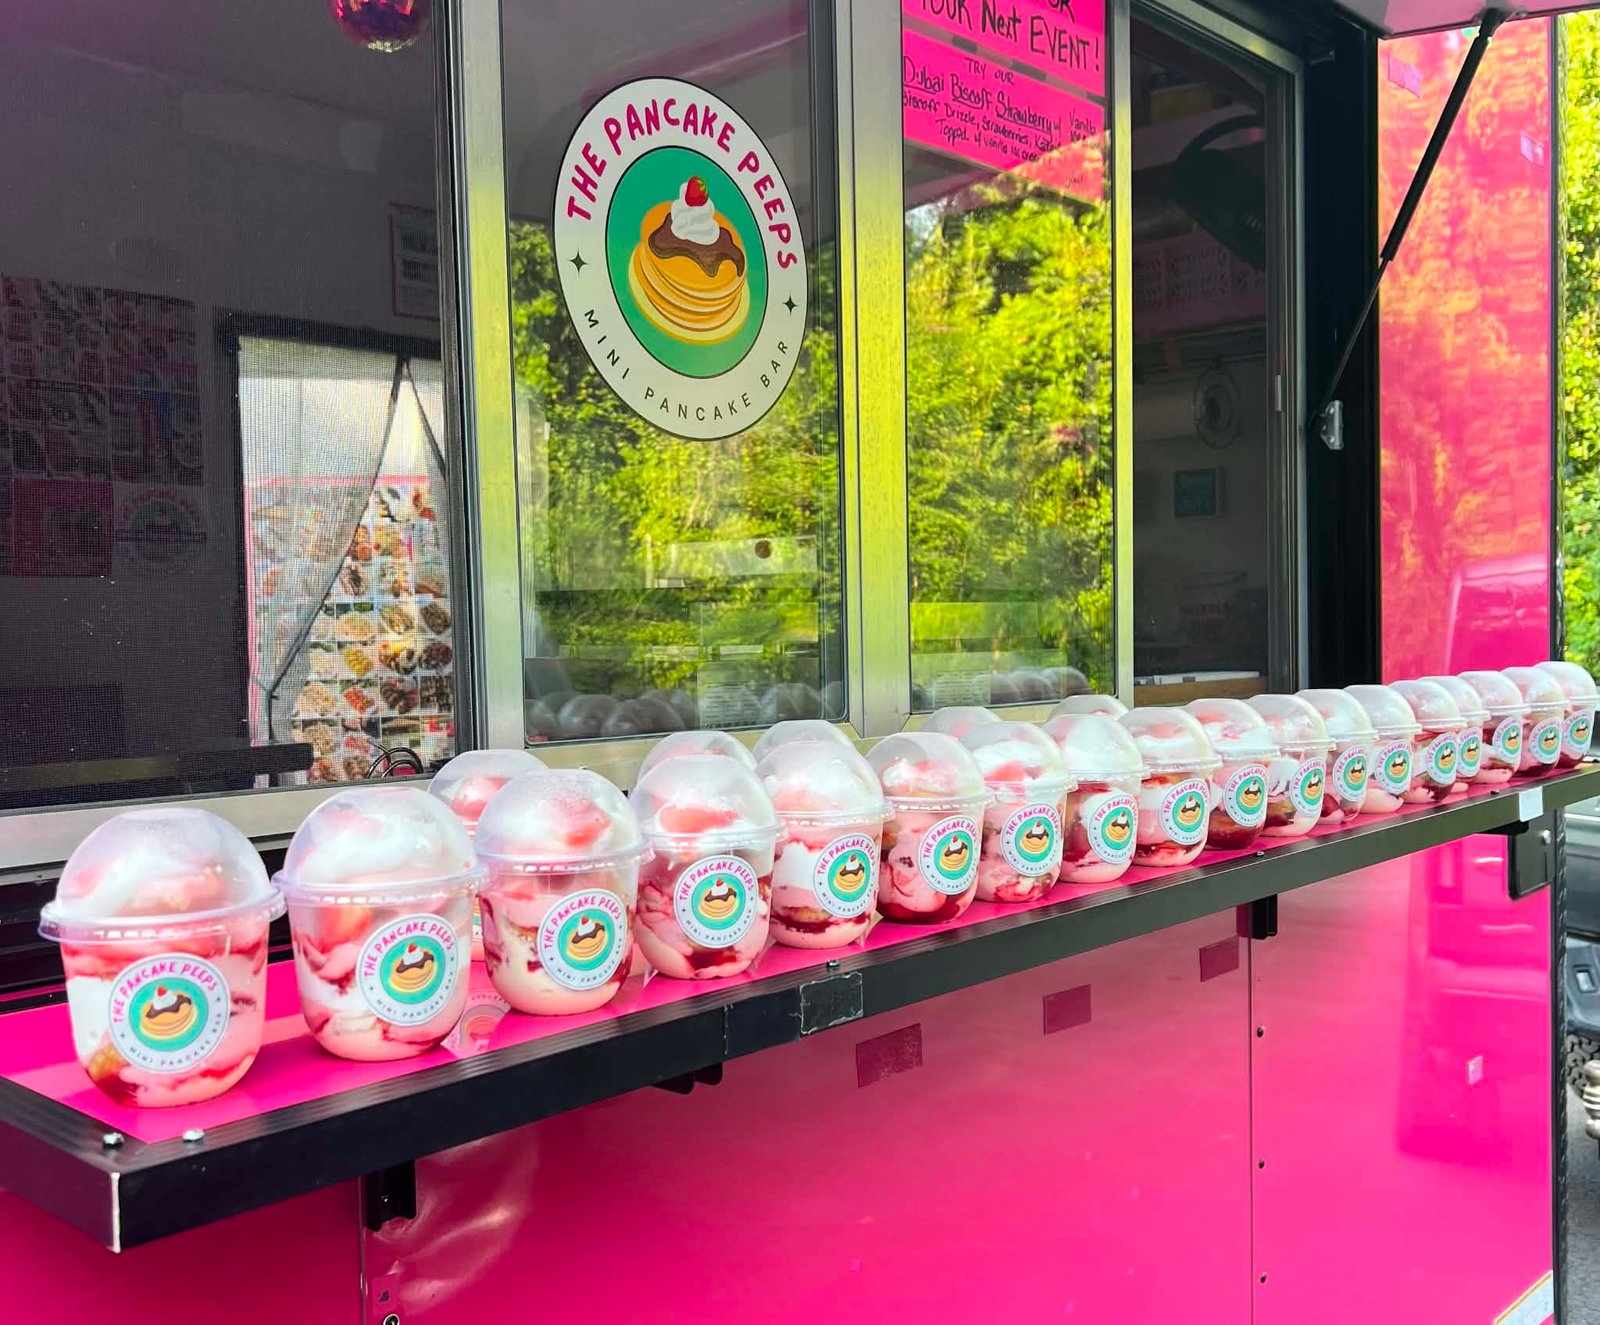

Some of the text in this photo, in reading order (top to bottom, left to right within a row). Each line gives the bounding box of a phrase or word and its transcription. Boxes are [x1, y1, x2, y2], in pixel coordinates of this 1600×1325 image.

[981, 0, 1021, 42] Next
[964, 57, 986, 79] TRY
[903, 55, 944, 93] Dubai
[950, 73, 993, 110] Biscoff
[996, 91, 1052, 146] Strawberry
[567, 98, 798, 269] THE PANCAKE PEEPS
[584, 309, 788, 420] MINI PANCAKE BAR
[923, 842, 933, 858] THE
[931, 820, 965, 841] PANCAKE
[1006, 820, 1018, 836] THE
[679, 861, 754, 901] THE PANCAKE PEEPS
[817, 857, 829, 875] THE
[829, 839, 864, 858] PANCAKE
[544, 895, 622, 949] THE PANCAKE PEEPS
[364, 921, 454, 977] THE PANCAKE PEEPS
[112, 962, 218, 1023] THE PANCAKE PEEPS
